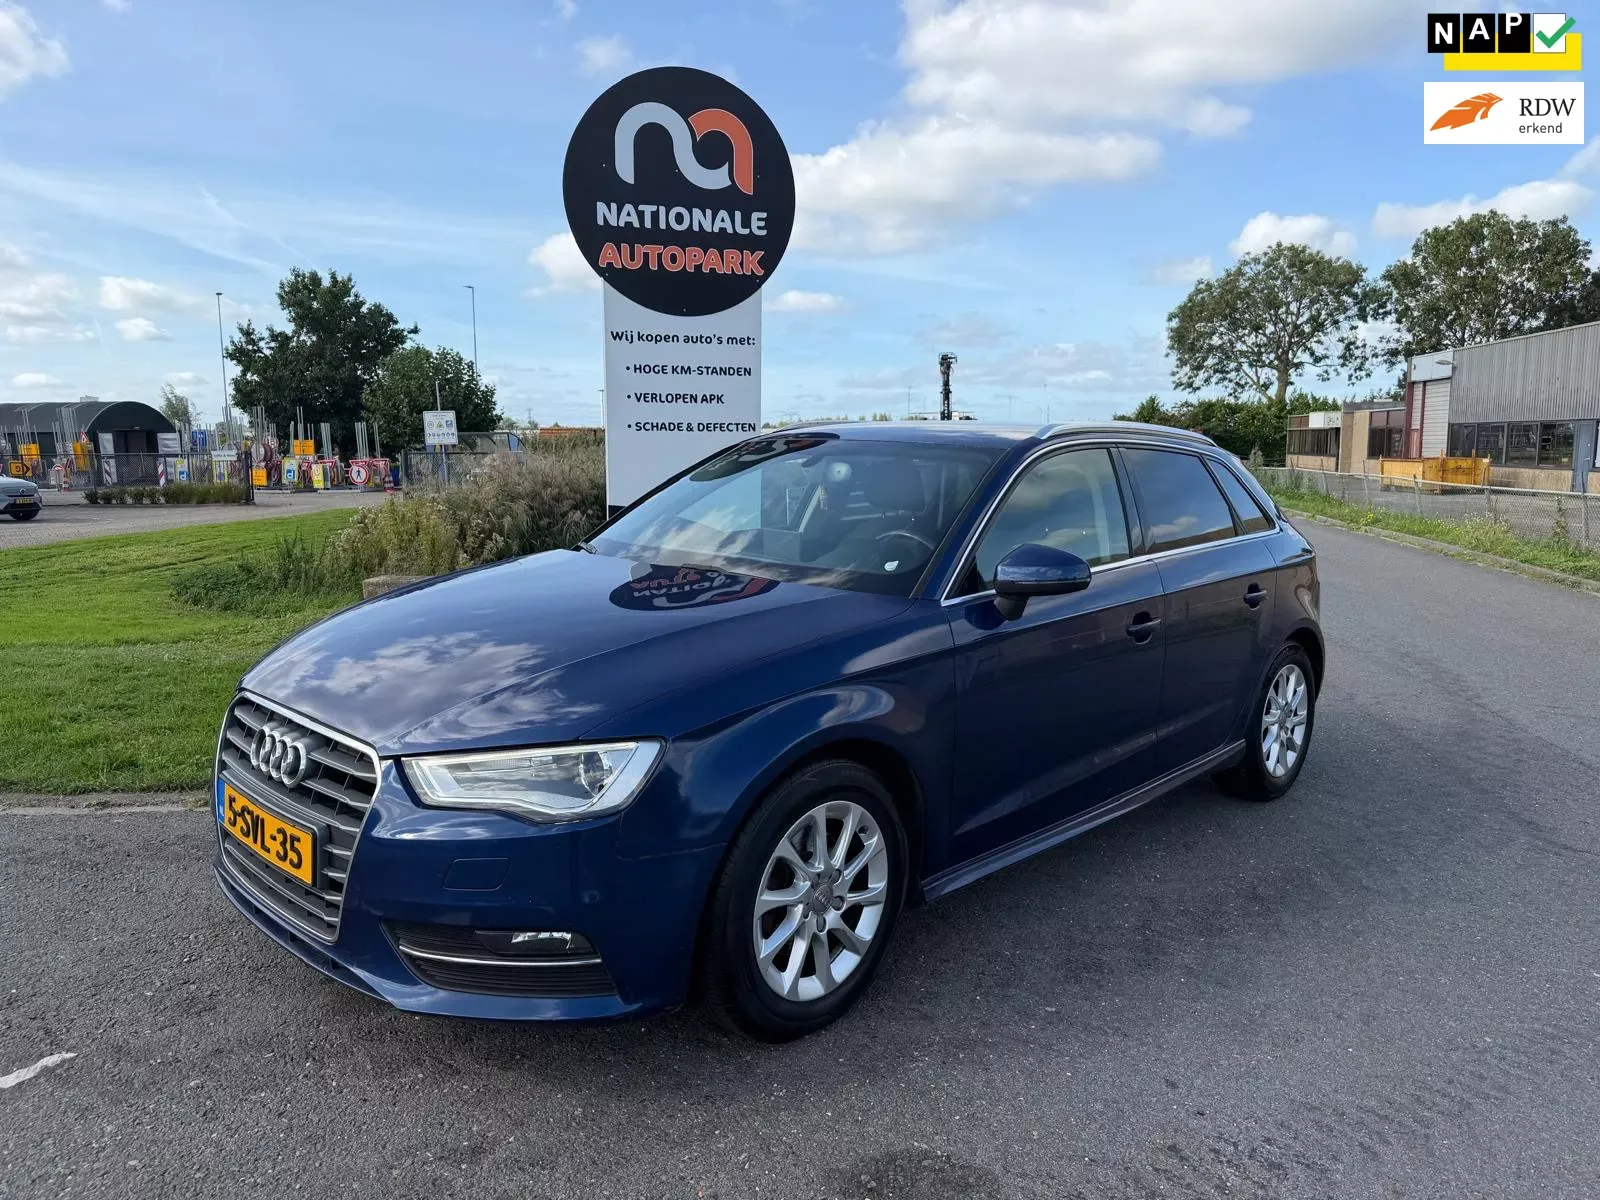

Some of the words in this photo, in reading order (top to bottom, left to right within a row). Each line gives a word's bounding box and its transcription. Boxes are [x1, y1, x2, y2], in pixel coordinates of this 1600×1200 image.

[596, 201, 768, 236] NATIONALE
[598, 241, 765, 276] AUTOPARK
[610, 330, 634, 344] Wij
[637, 331, 680, 345] kopen
[683, 333, 723, 345] auto's
[726, 335, 756, 346] met:
[633, 364, 668, 375] HOGE
[671, 365, 752, 377] KM-STANDEN
[634, 392, 698, 404] VERLOPEN
[700, 393, 725, 405] APK
[634, 421, 684, 432] SCHADE
[685, 422, 695, 432] &
[697, 422, 756, 433] DEFECTEN
[228, 793, 303, 870] 5-SVL-35
